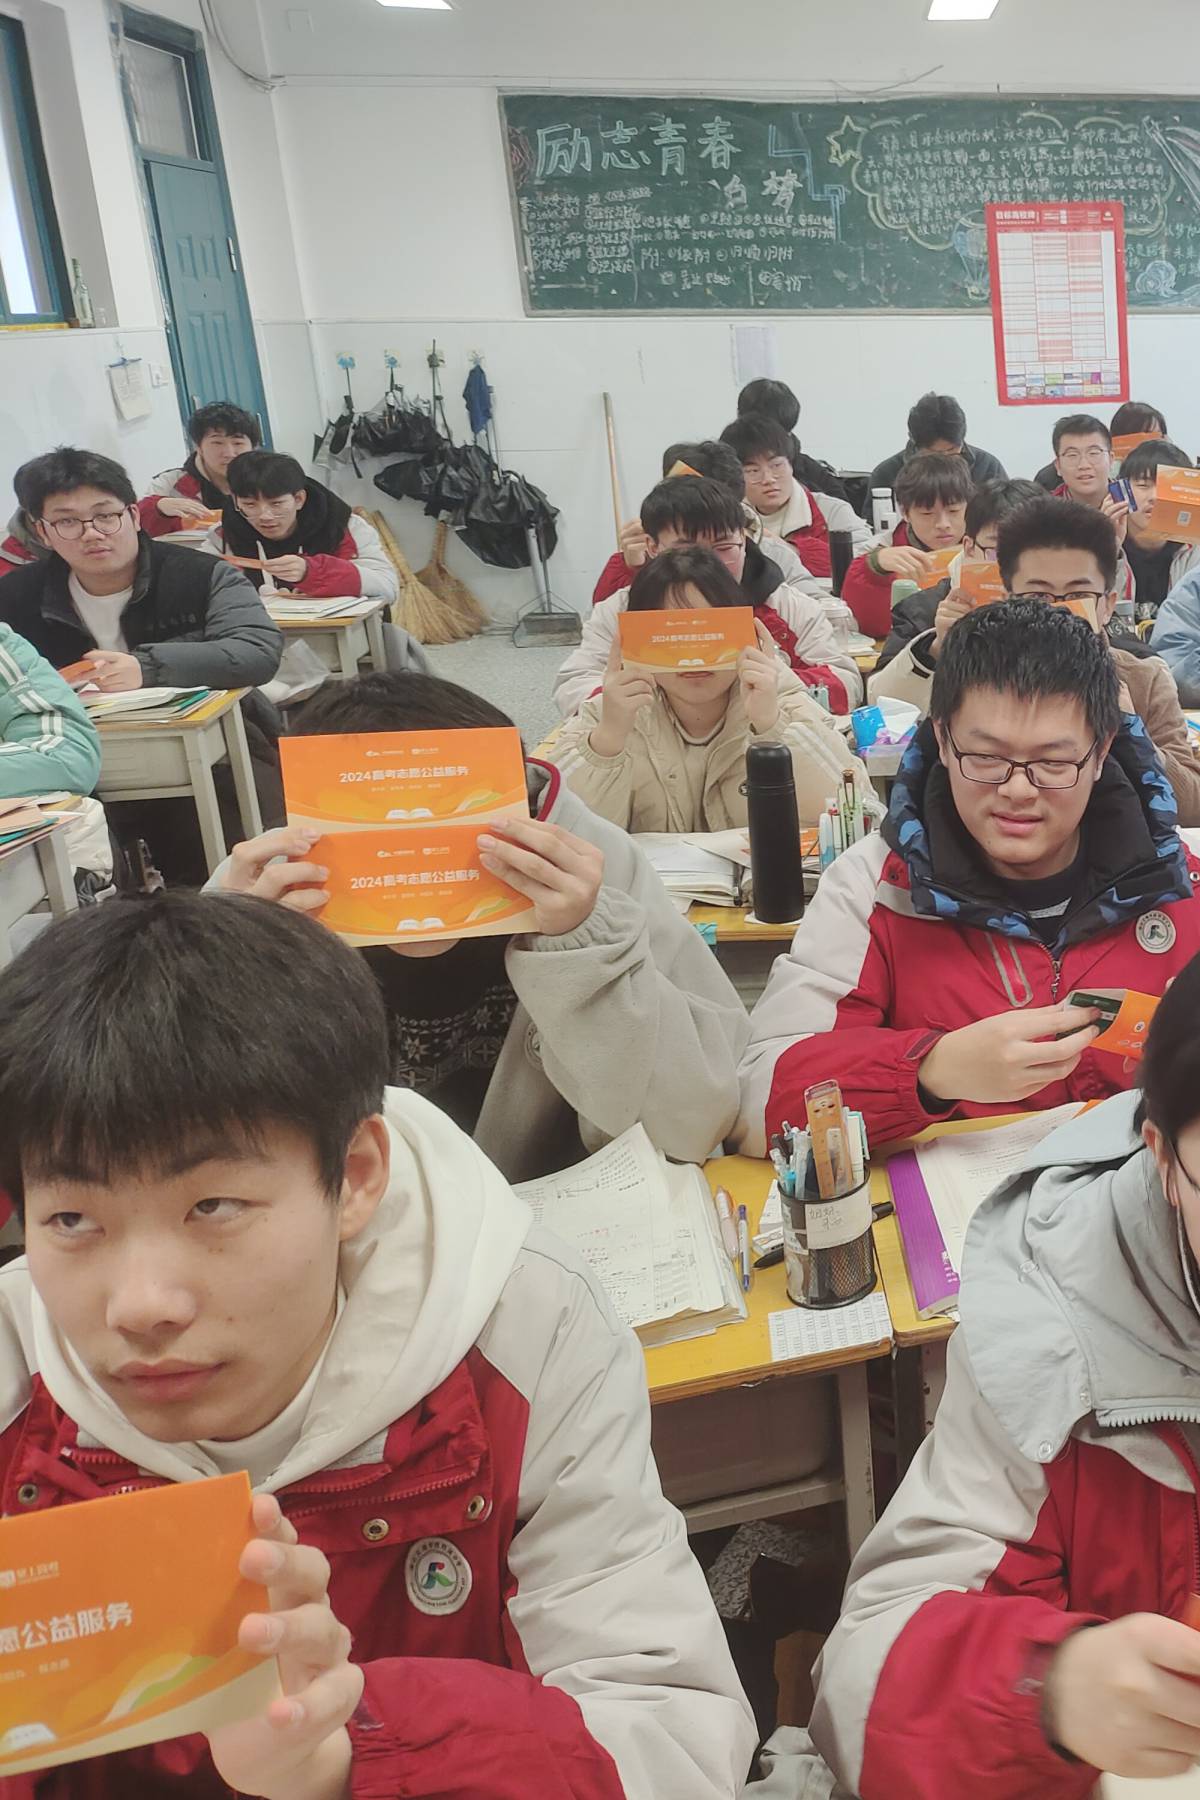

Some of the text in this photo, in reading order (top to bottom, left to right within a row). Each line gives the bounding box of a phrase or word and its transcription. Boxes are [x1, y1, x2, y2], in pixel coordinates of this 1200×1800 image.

[536, 115, 742, 177] 励志青春
[339, 766, 470, 783] 2024高考志愿公益服务
[350, 869, 480, 889] 2024高考志愿公益服务
